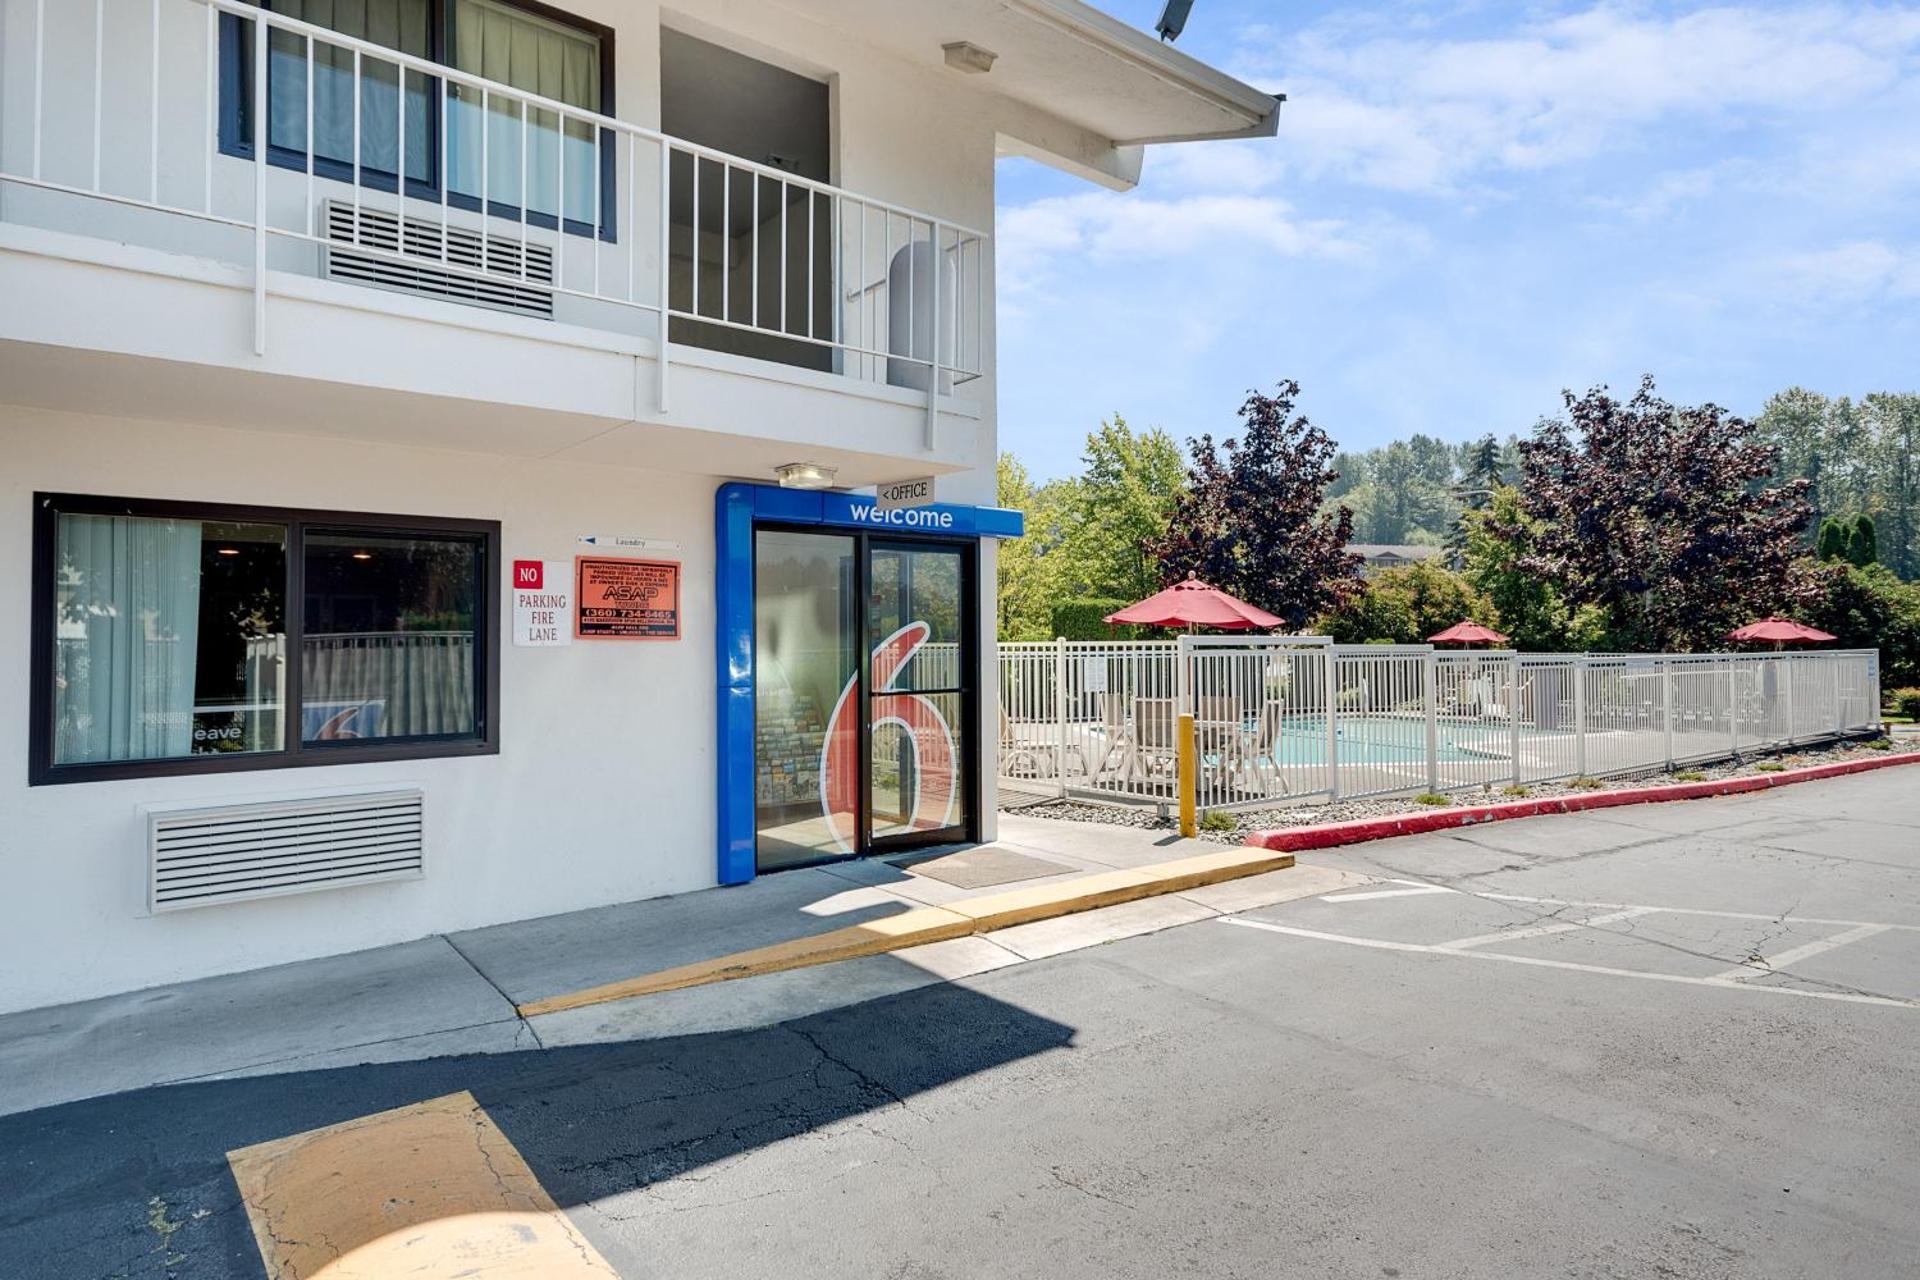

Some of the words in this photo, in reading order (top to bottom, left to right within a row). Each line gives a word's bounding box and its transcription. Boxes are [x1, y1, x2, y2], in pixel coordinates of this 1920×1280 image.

[891, 482, 927, 500] OFFICE
[850, 504, 953, 528] welcome
[519, 568, 538, 582] NO
[602, 586, 659, 600] ASAP
[519, 594, 567, 609] PARKING
[531, 611, 556, 625] FIRE
[586, 609, 616, 617] (360)
[529, 628, 558, 641] LANE
[194, 727, 242, 741] eave
